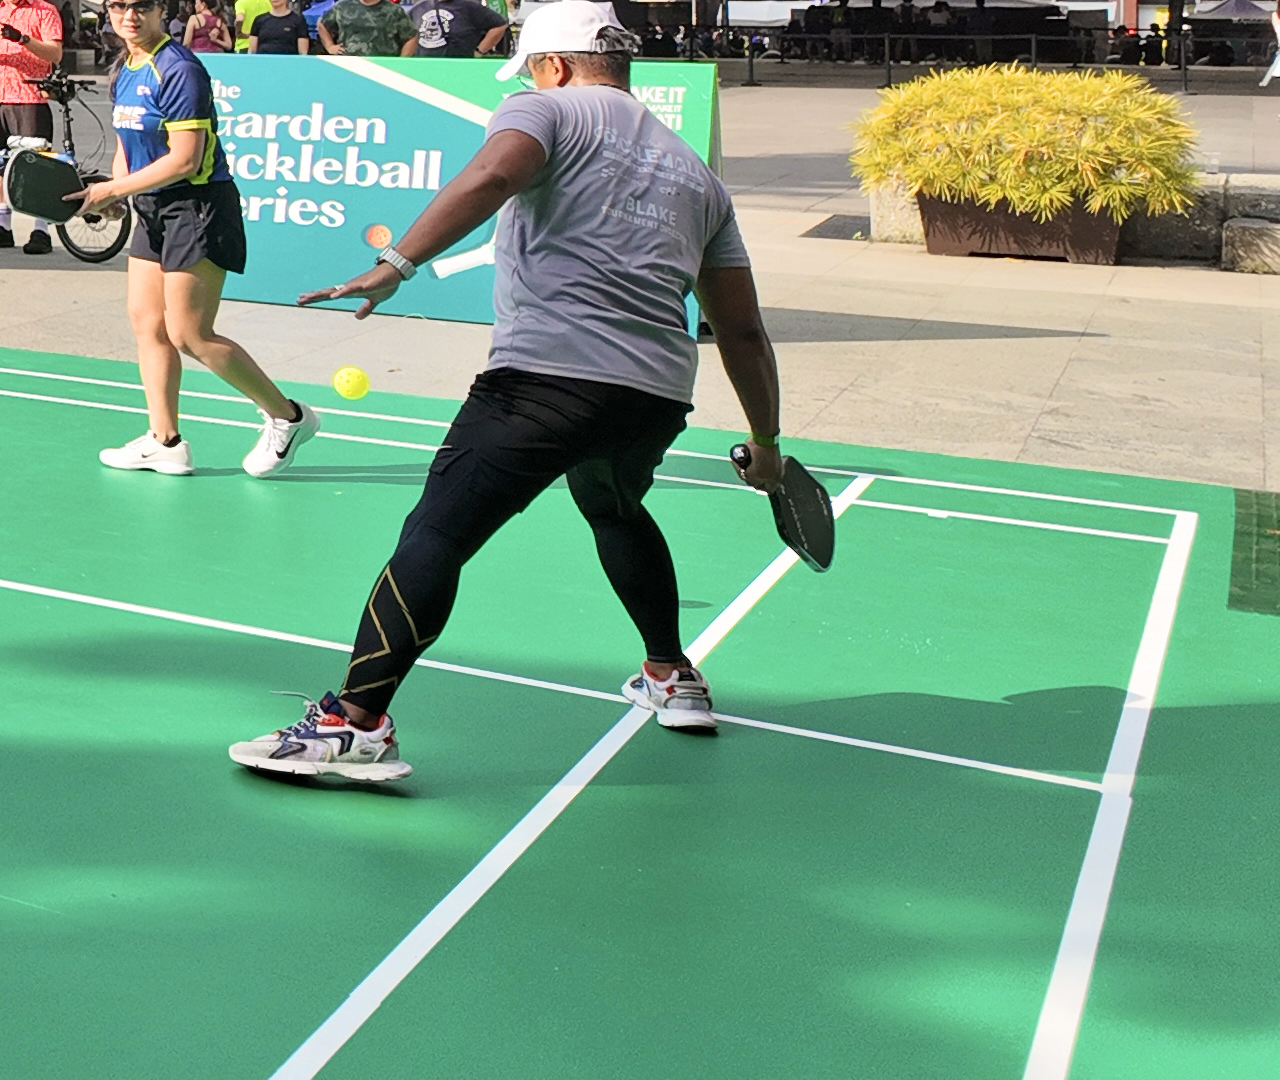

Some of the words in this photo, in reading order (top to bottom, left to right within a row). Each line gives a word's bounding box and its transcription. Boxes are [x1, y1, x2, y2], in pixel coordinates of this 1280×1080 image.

[669, 86, 687, 104] IT
[224, 141, 443, 191] ickleball
[239, 185, 346, 228] ries
[600, 205, 659, 230] TOURNAMENT
[625, 195, 678, 227] BLAKE
